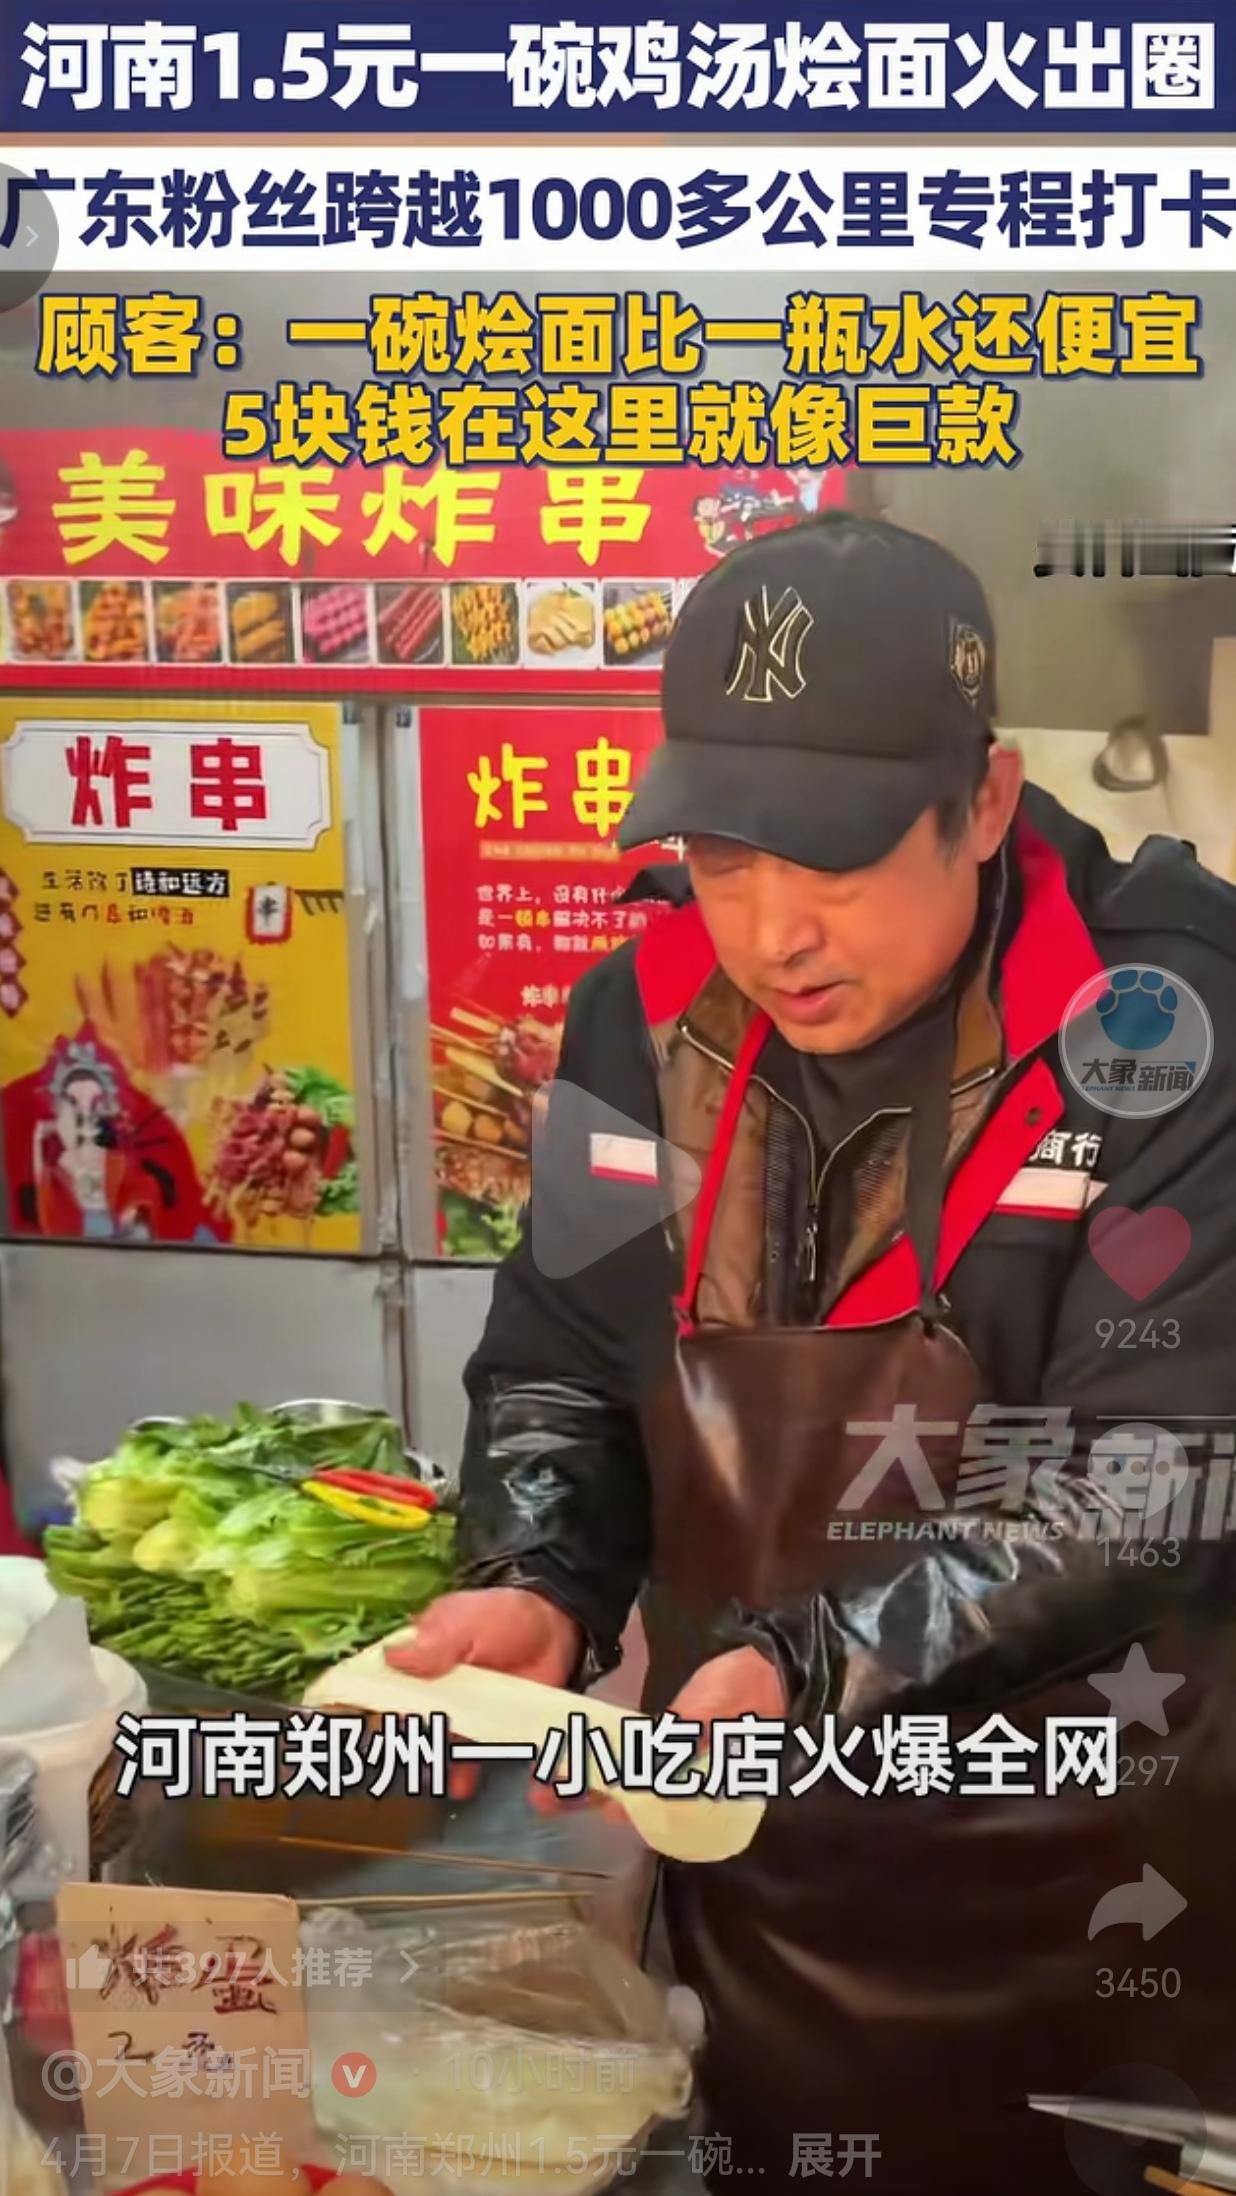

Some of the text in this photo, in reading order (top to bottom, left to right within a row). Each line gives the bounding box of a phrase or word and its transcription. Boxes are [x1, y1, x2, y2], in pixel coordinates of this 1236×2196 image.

[52, 449, 651, 567] 美味炸串
[65, 736, 267, 831] 炸串
[466, 736, 636, 838] 炸串
